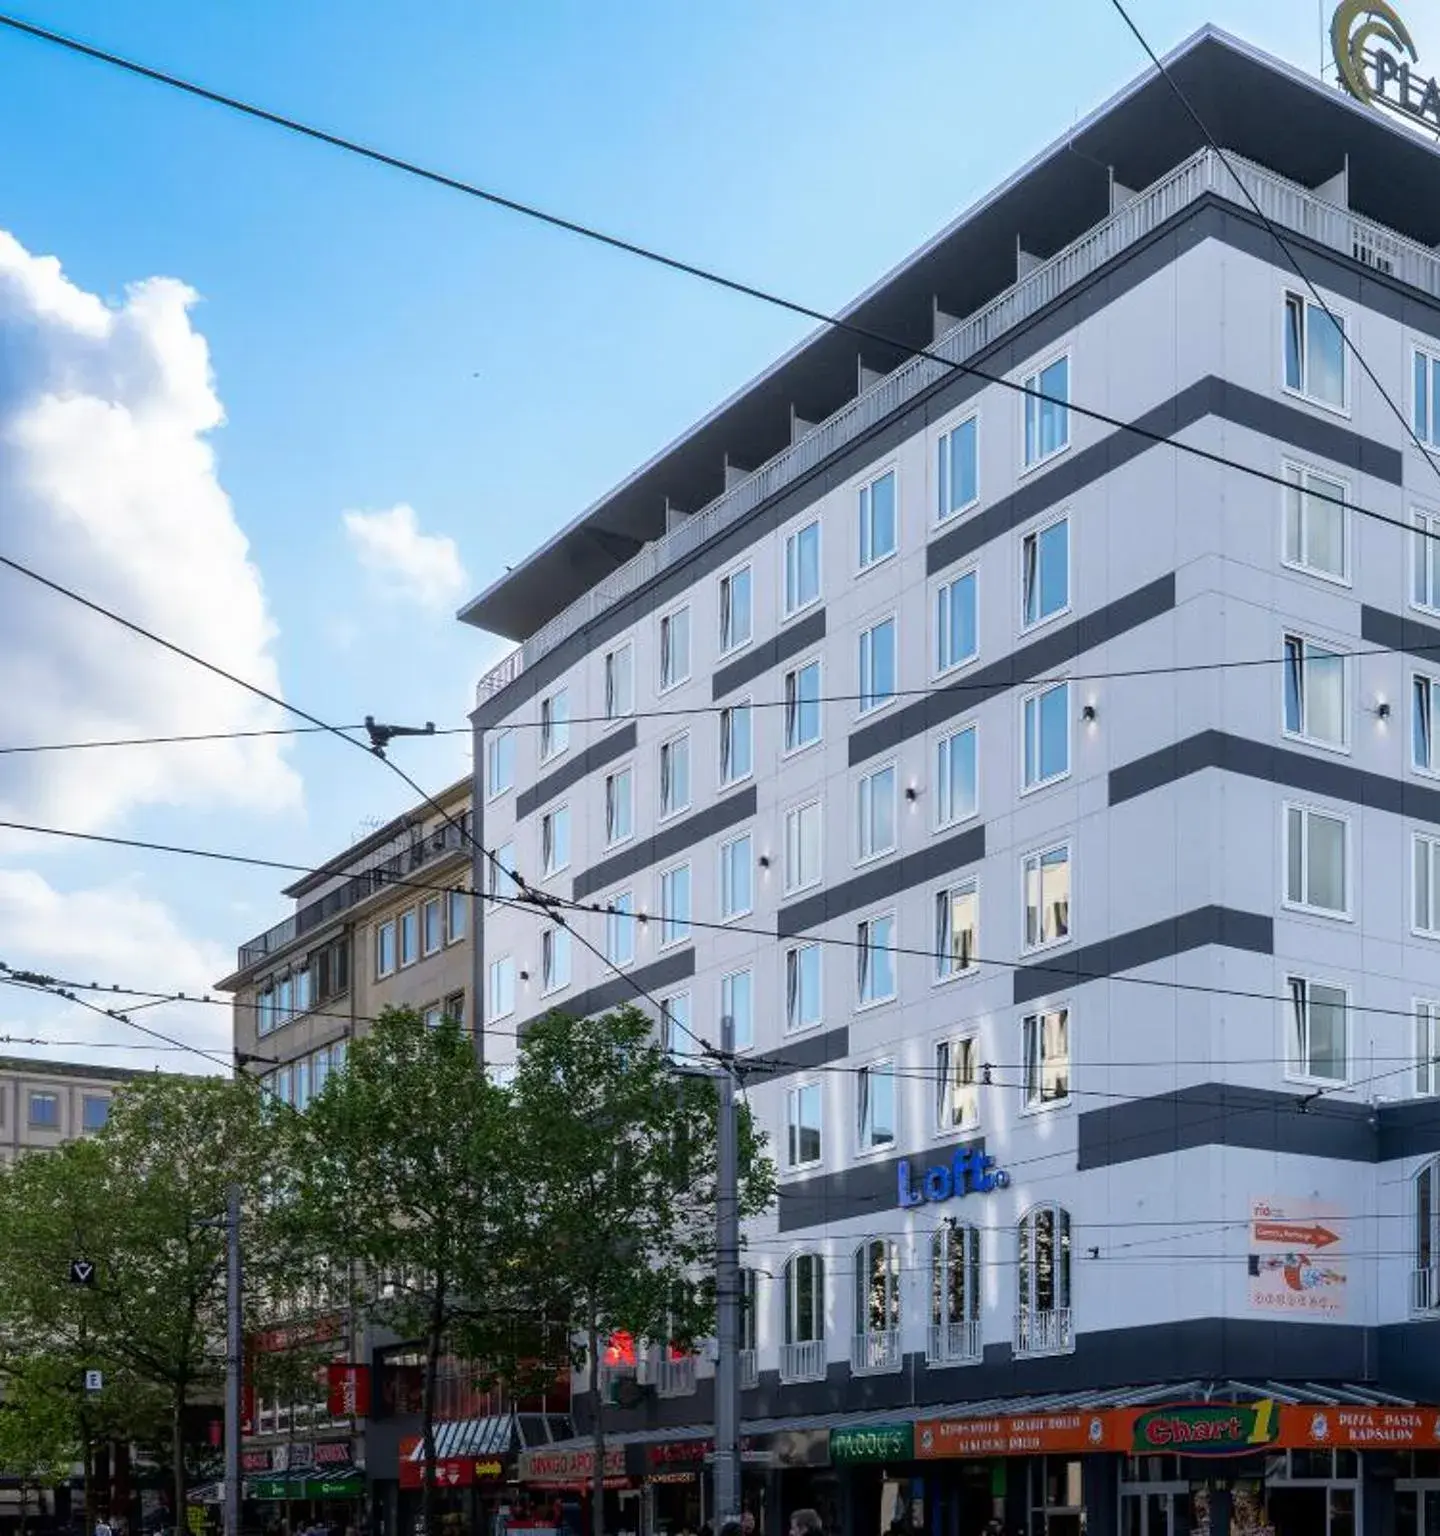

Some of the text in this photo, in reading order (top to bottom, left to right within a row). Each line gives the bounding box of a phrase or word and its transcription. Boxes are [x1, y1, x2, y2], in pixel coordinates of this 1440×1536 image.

[897, 1146, 997, 1210] Loft
[1145, 1399, 1274, 1444] Chart 1
